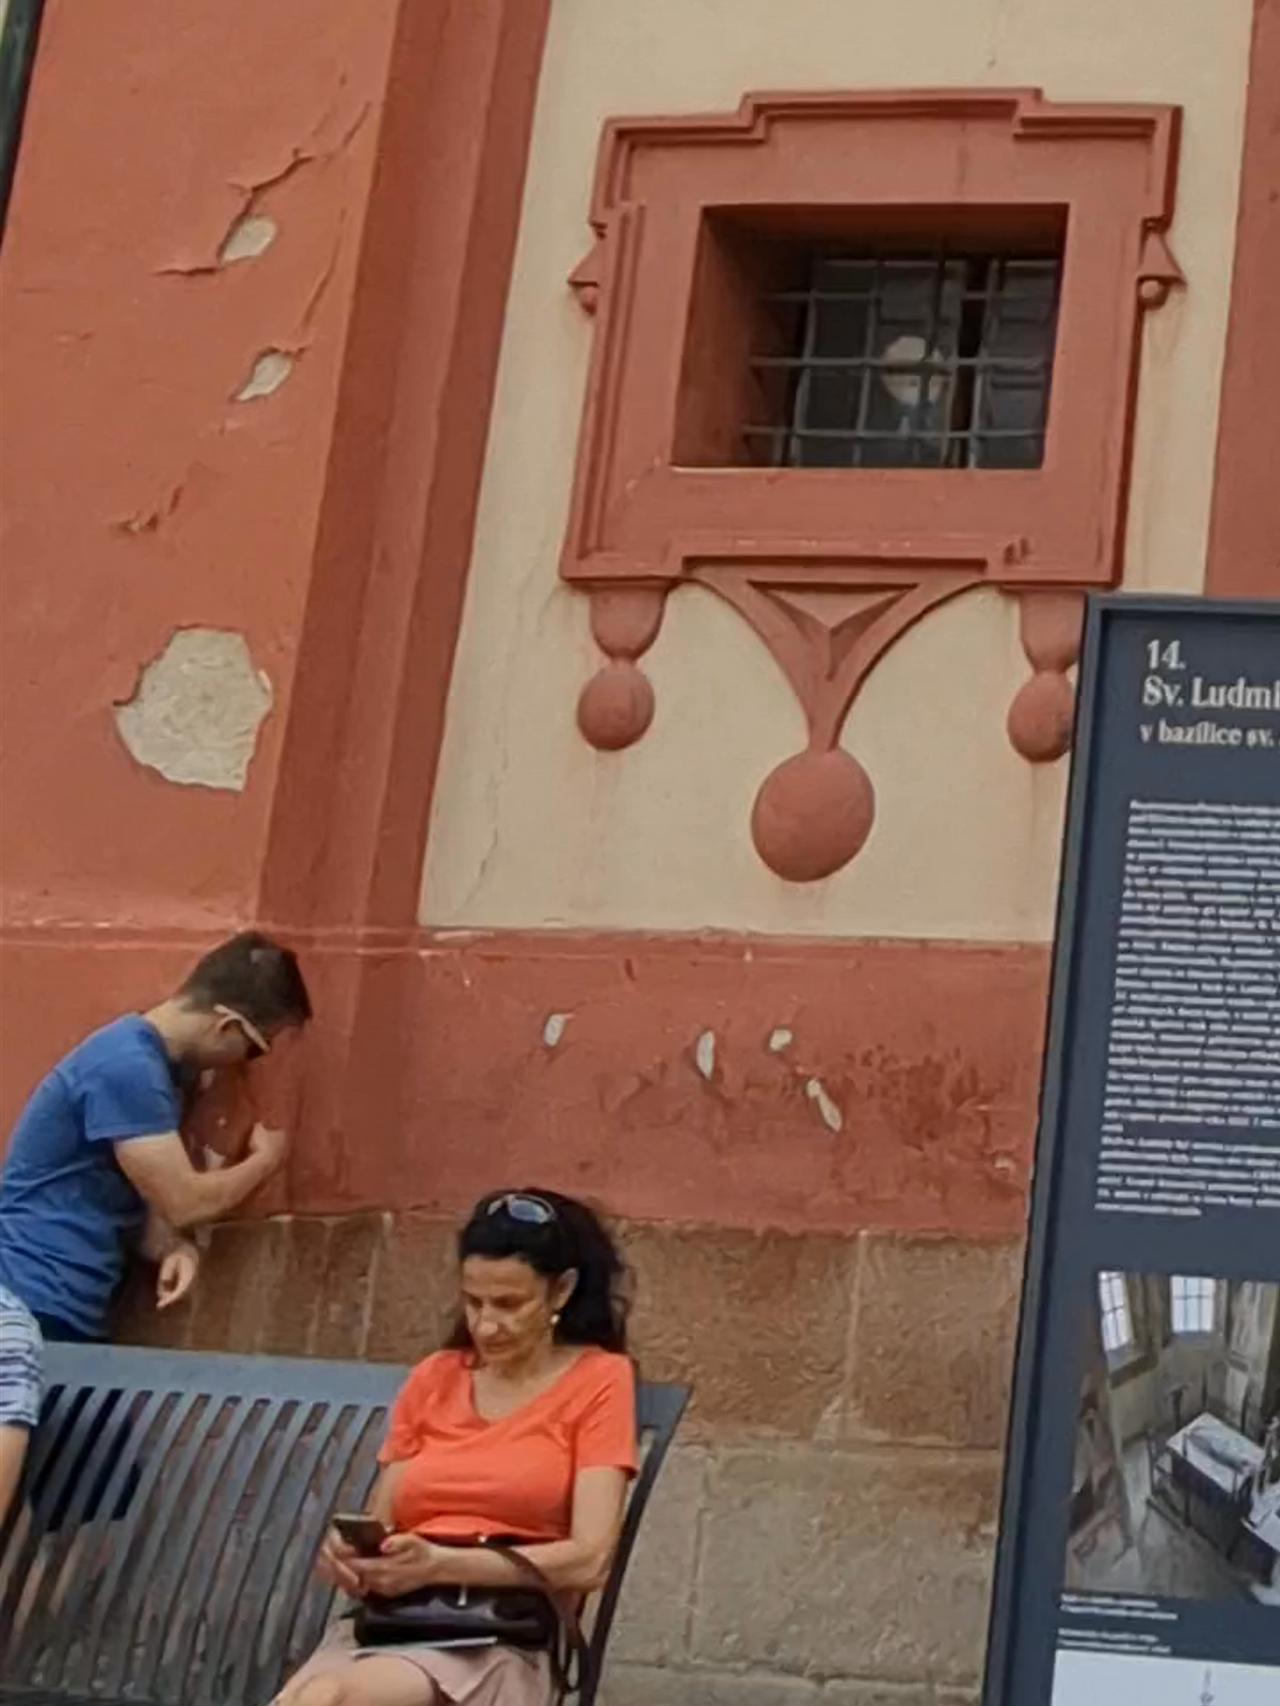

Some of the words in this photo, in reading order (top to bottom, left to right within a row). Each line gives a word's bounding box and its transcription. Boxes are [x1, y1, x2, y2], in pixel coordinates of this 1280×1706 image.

[1147, 639, 1187, 670] 14.
[1143, 675, 1185, 707] Sv.
[1140, 723, 1154, 743] v
